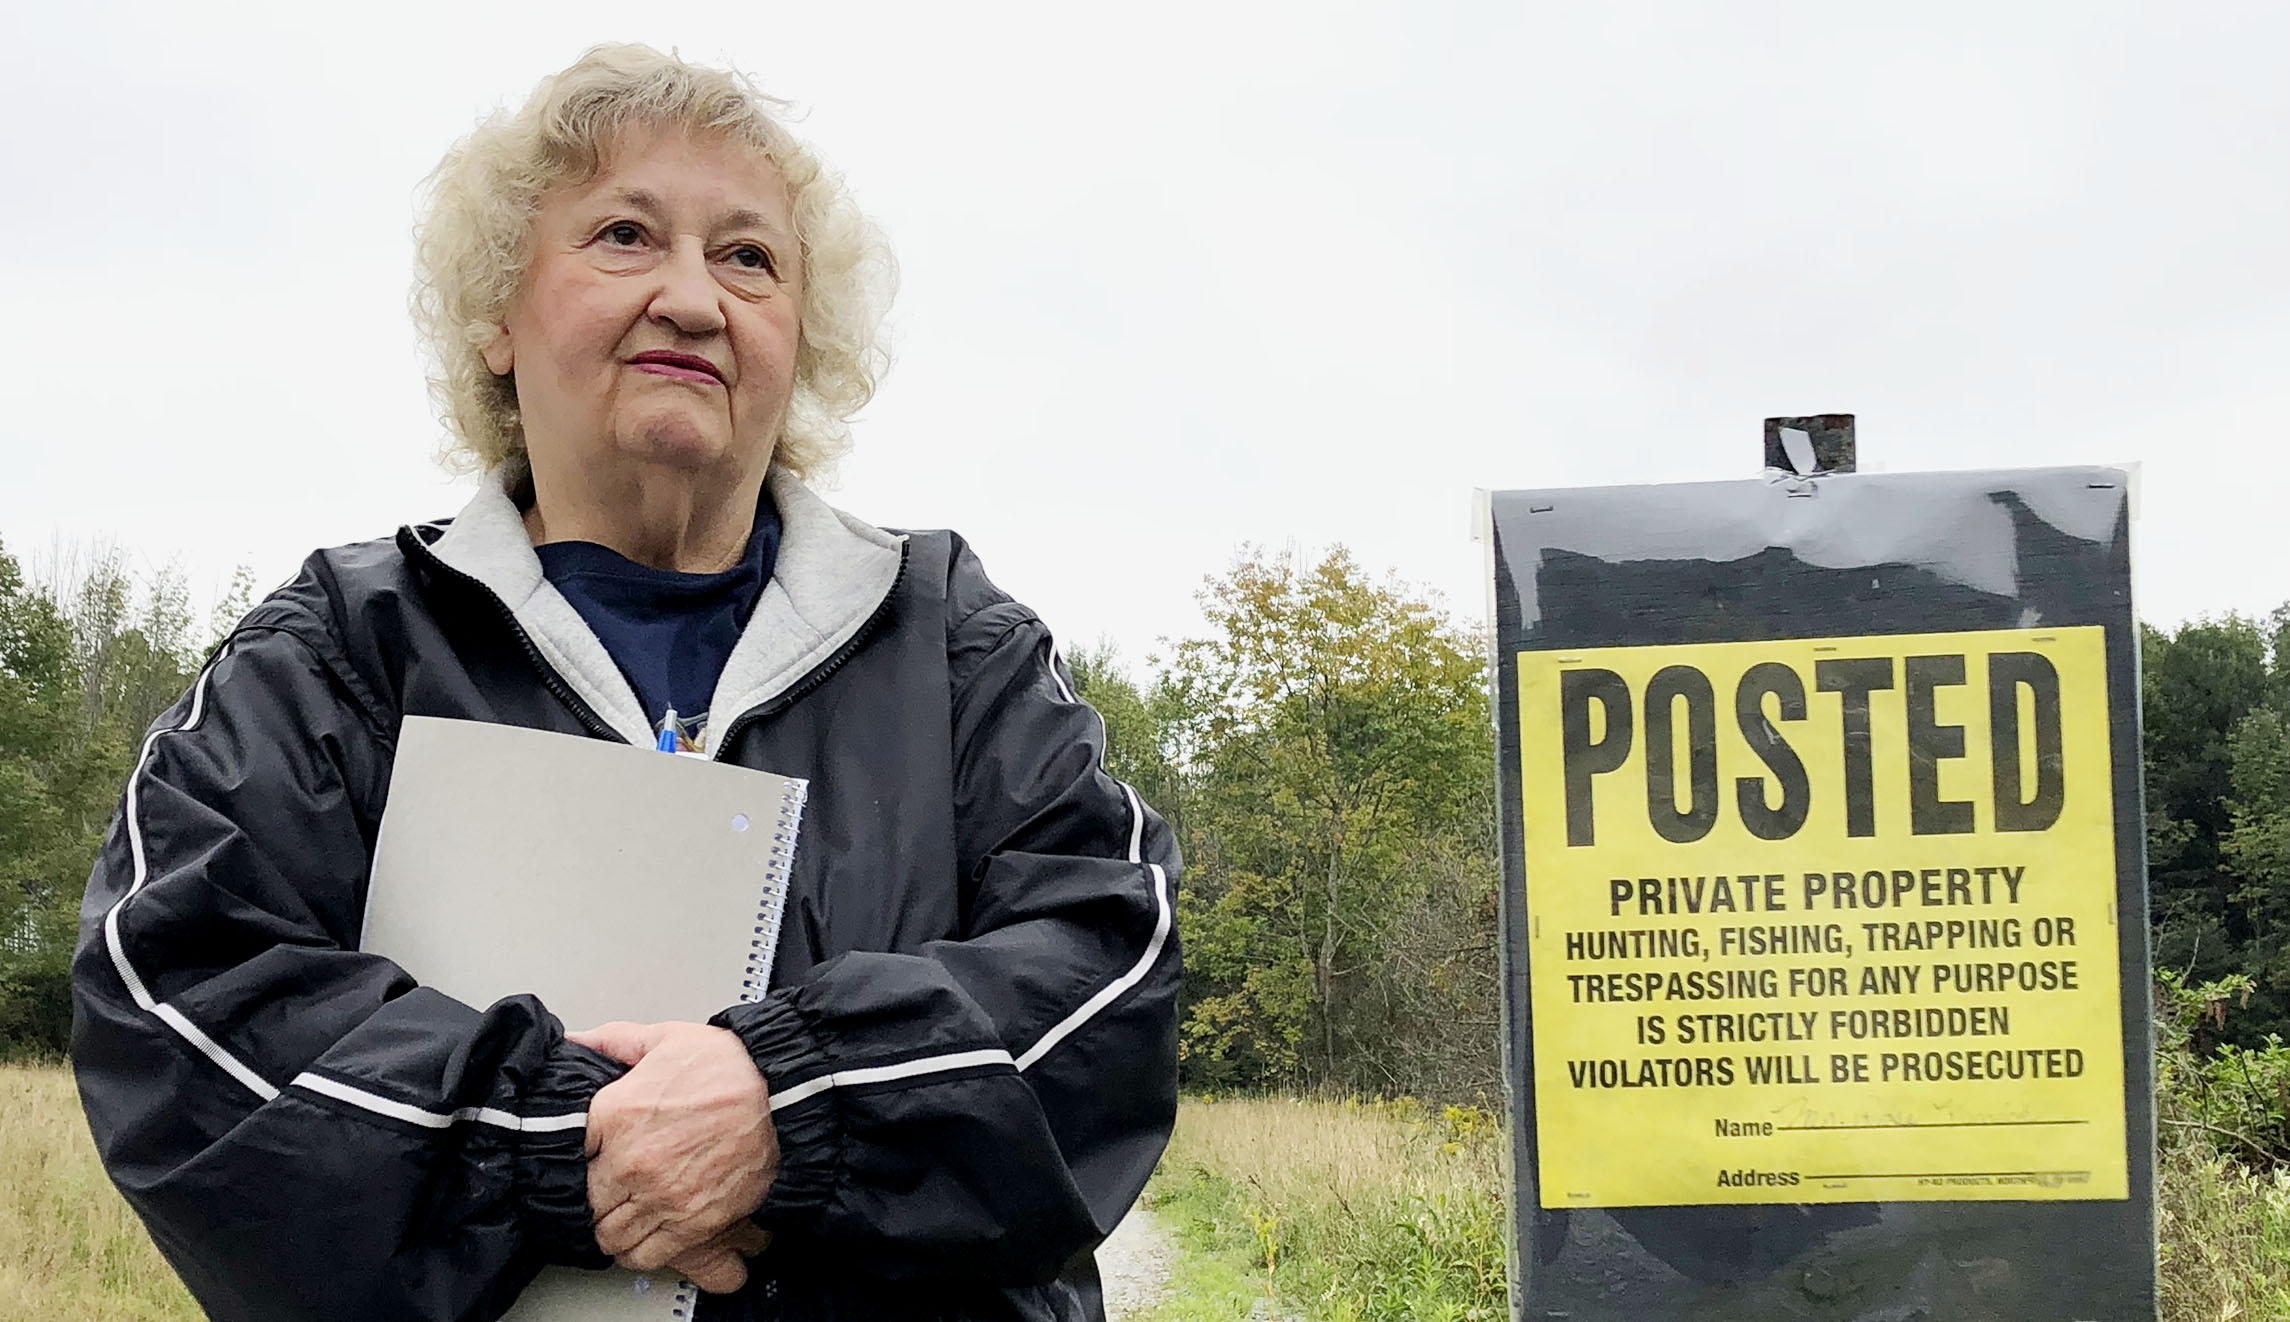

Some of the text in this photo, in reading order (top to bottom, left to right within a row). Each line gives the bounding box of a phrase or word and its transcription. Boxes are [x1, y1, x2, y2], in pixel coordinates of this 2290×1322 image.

[1559, 651, 2065, 847] POSTED
[1610, 867, 2025, 916] PRIVATE PROPERTY
[1566, 918, 2075, 962] HUNTING, FISHING, TRAPPING OR
[1567, 961, 2078, 1002] TRESPASSING FOR ANY PURPOSE
[1638, 1007, 2008, 1044] IS STRICTLY FORBIDDEN
[1568, 1049, 2083, 1088] VIOLATORS WILL BE PROSECUTED
[1716, 1119, 1772, 1136] Name
[1717, 1169, 1799, 1187] Address
